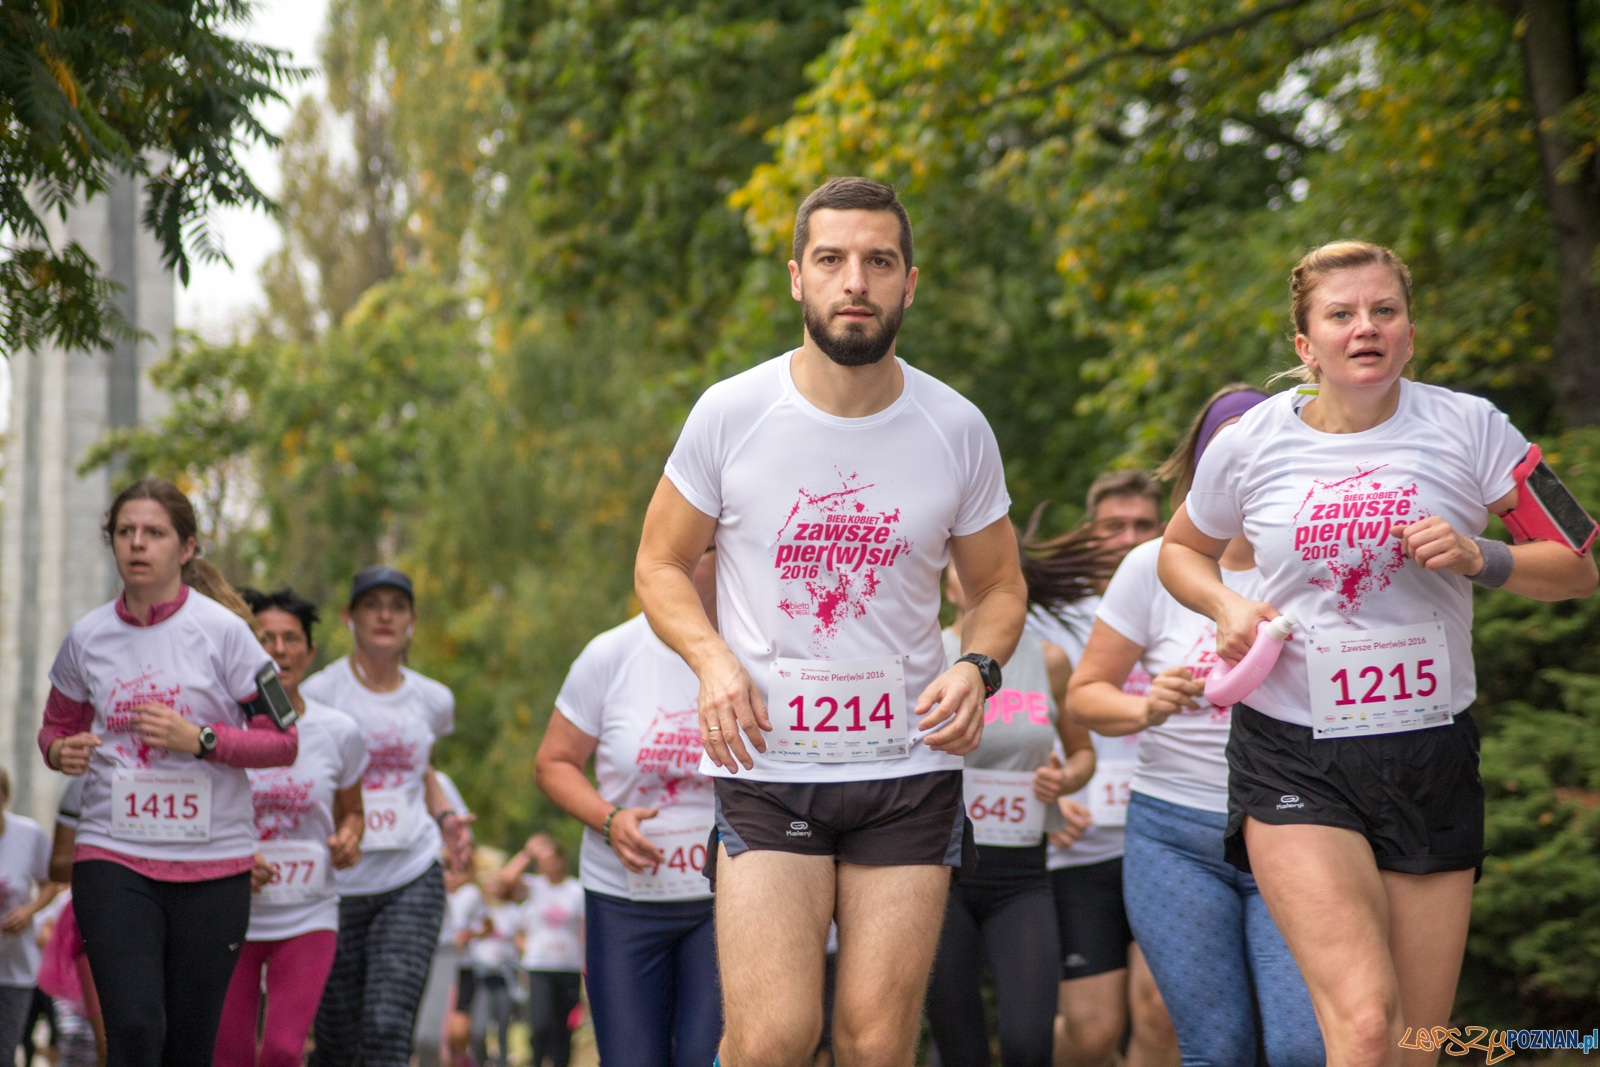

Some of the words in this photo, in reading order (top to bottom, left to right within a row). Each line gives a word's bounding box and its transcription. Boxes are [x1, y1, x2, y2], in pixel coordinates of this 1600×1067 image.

[1343, 494, 1364, 502] BIEG
[1366, 491, 1399, 500] KOBIET
[826, 514, 847, 523] BIEG
[848, 515, 880, 525] KOBIET
[1310, 499, 1411, 521] zawsze
[793, 523, 891, 544] zawsze
[1294, 516, 1425, 551] pier(w)
[774, 542, 901, 572] pier(w)si!
[1302, 543, 1339, 561] 2016
[780, 564, 819, 579] 2016
[1341, 644, 1371, 653] Zawsze
[1408, 637, 1426, 646] 2016
[800, 672, 829, 681] Zawsze
[831, 672, 865, 682] Pier(w)si
[866, 670, 885, 679] 2016
[1330, 659, 1437, 706] 1215
[788, 693, 894, 732] 1214
[125, 792, 199, 819] 1415
[969, 794, 1026, 823] 645
